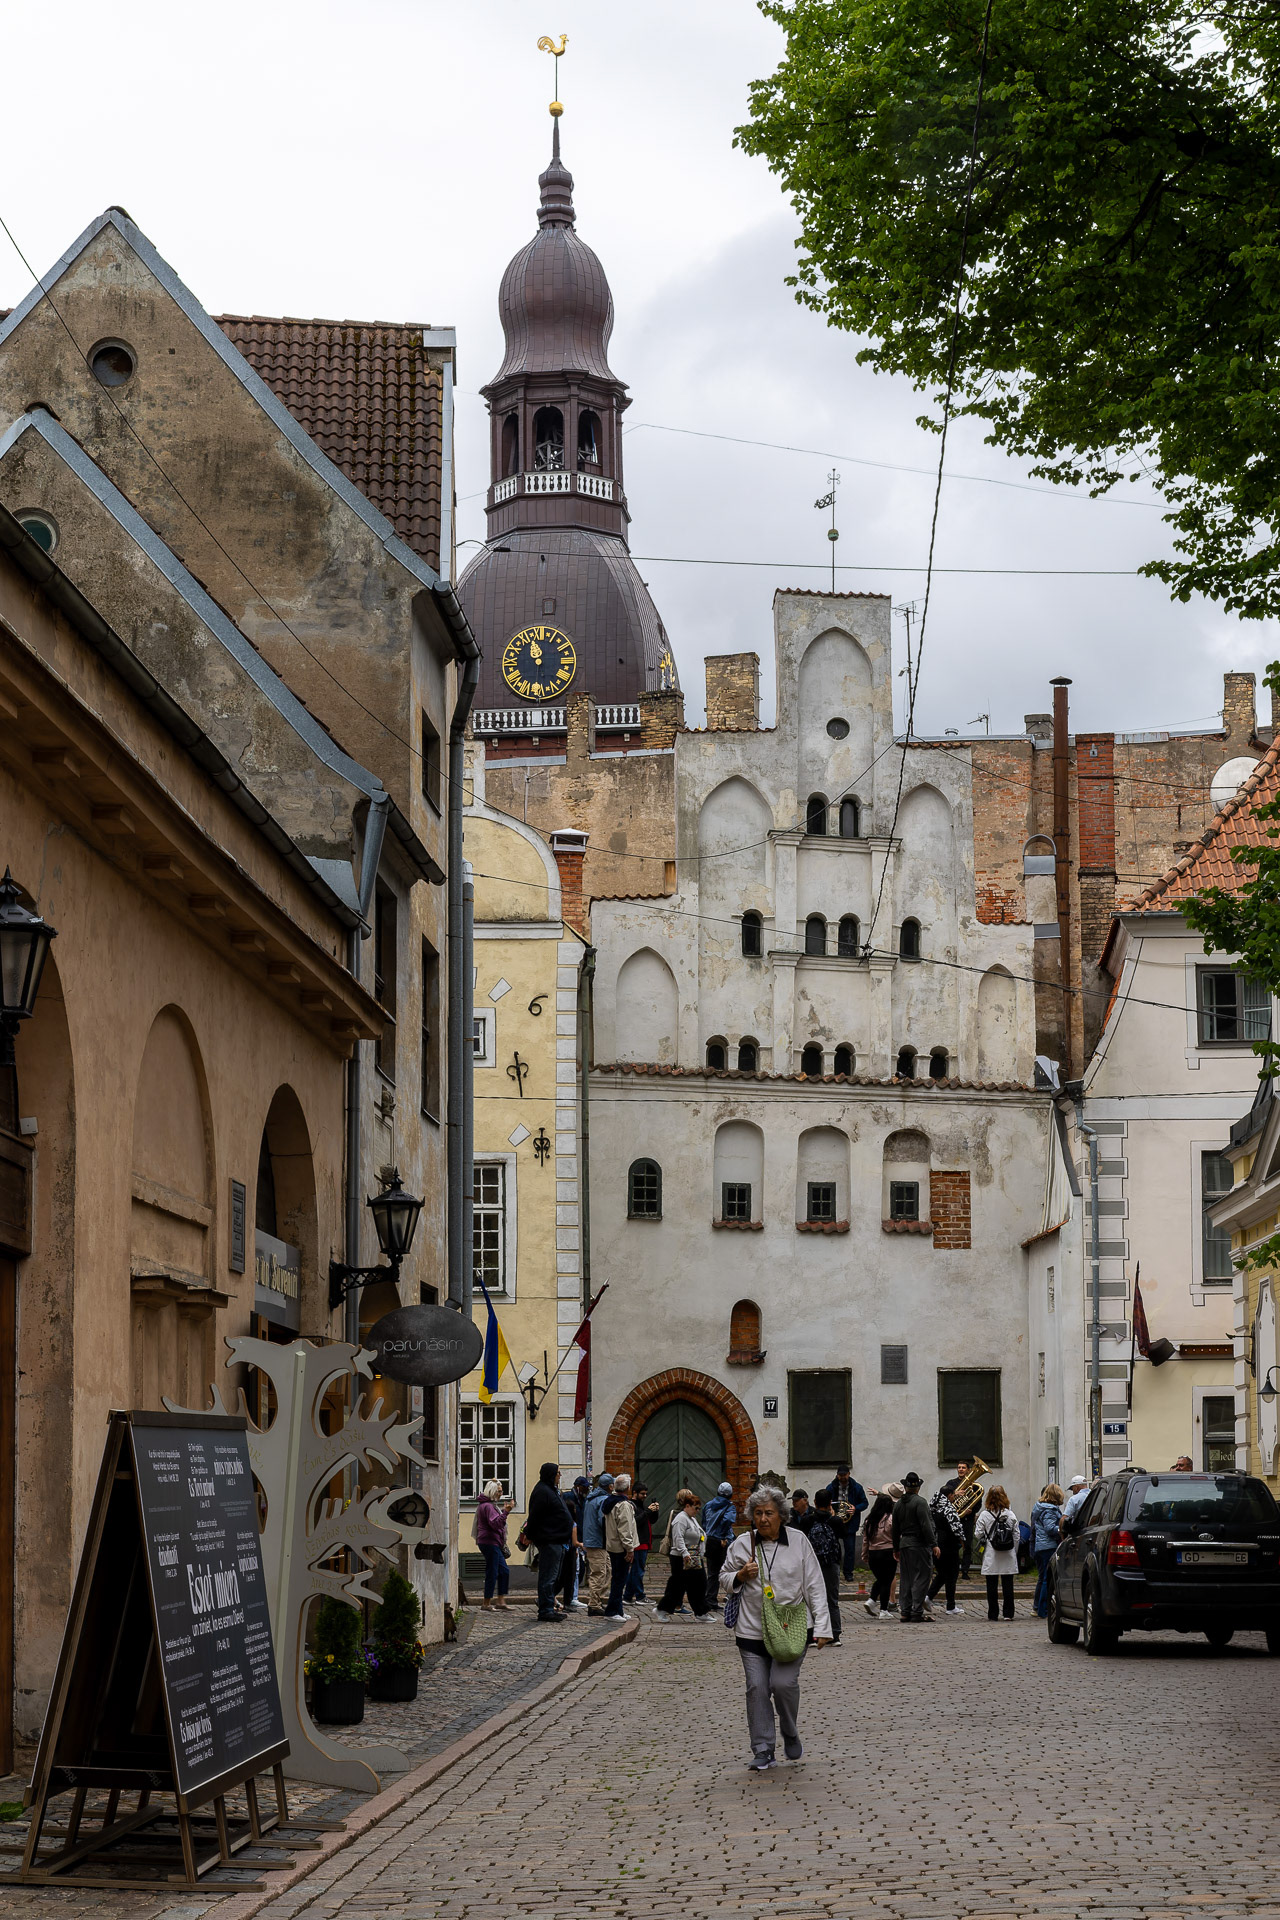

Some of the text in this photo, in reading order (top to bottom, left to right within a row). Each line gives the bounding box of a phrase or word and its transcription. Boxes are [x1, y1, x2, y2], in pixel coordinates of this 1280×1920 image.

[383, 1337, 464, 1355] parunāsim
[766, 1401, 776, 1410] 17
[1109, 1424, 1120, 1433] 15
[186, 1559, 241, 1615] Esiet mierā
[192, 1623, 200, 1637] un
